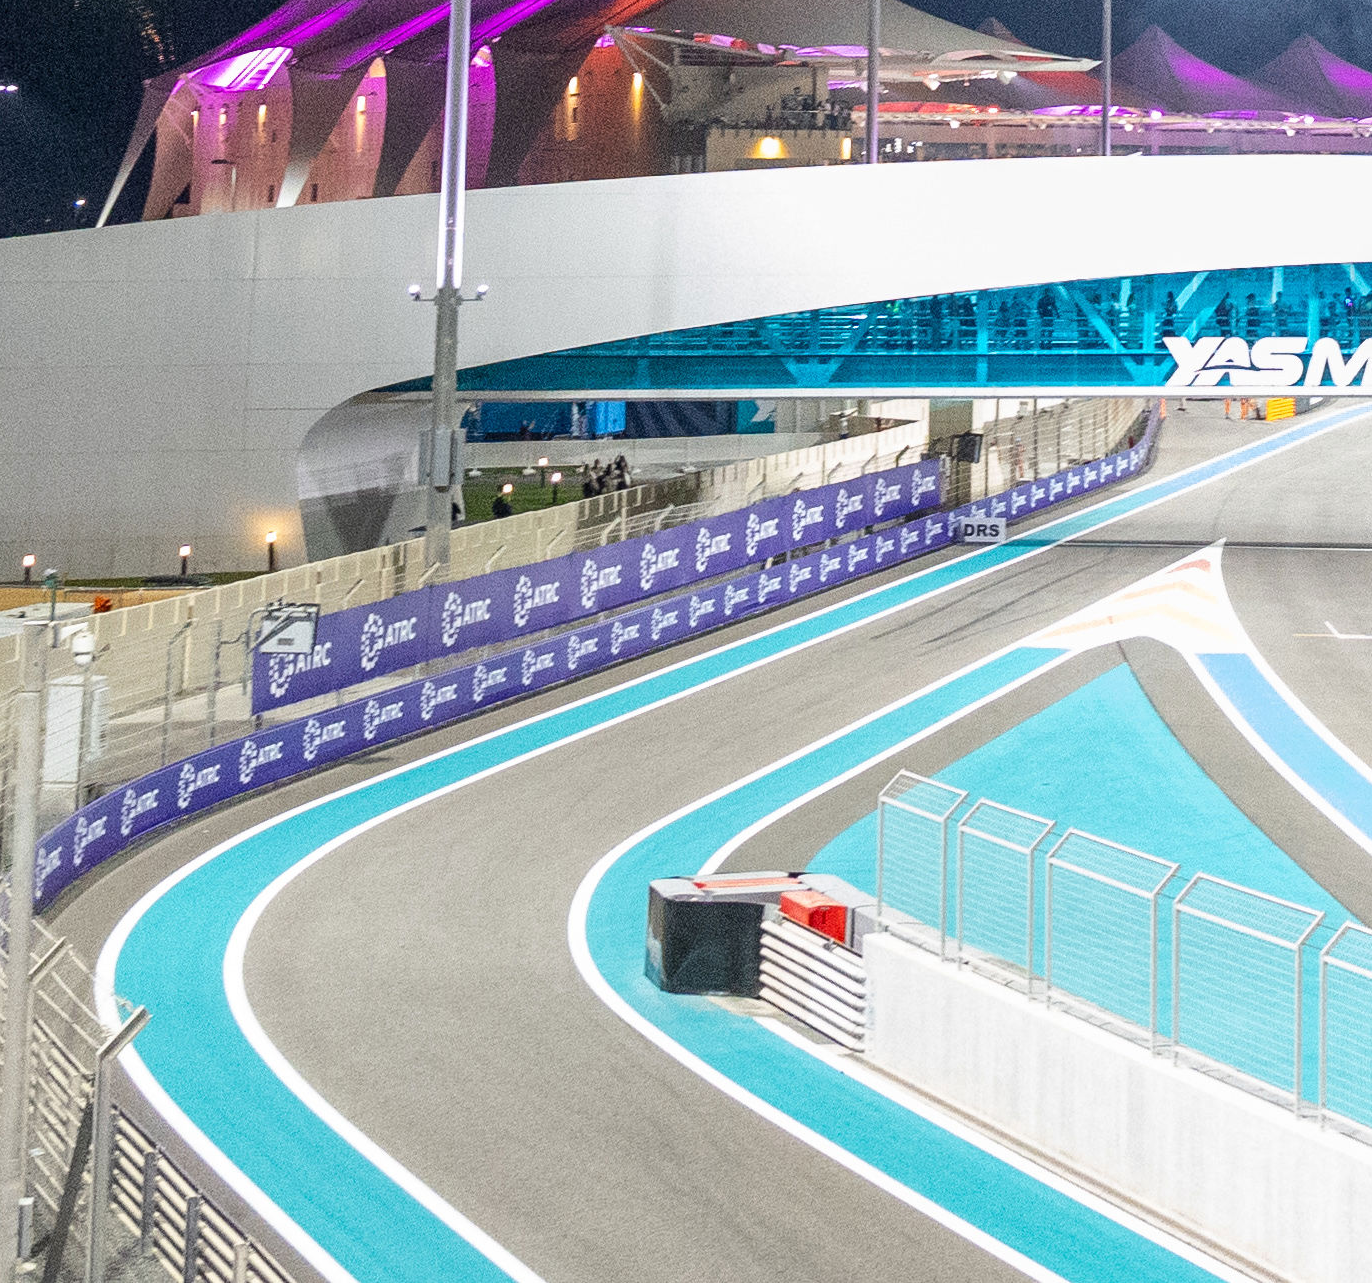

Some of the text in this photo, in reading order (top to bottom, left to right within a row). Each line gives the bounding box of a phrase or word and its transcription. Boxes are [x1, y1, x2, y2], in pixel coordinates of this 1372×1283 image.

[964, 524, 1000, 537] DRS
[462, 598, 491, 626] ATRC
[384, 617, 417, 648] ATRC
